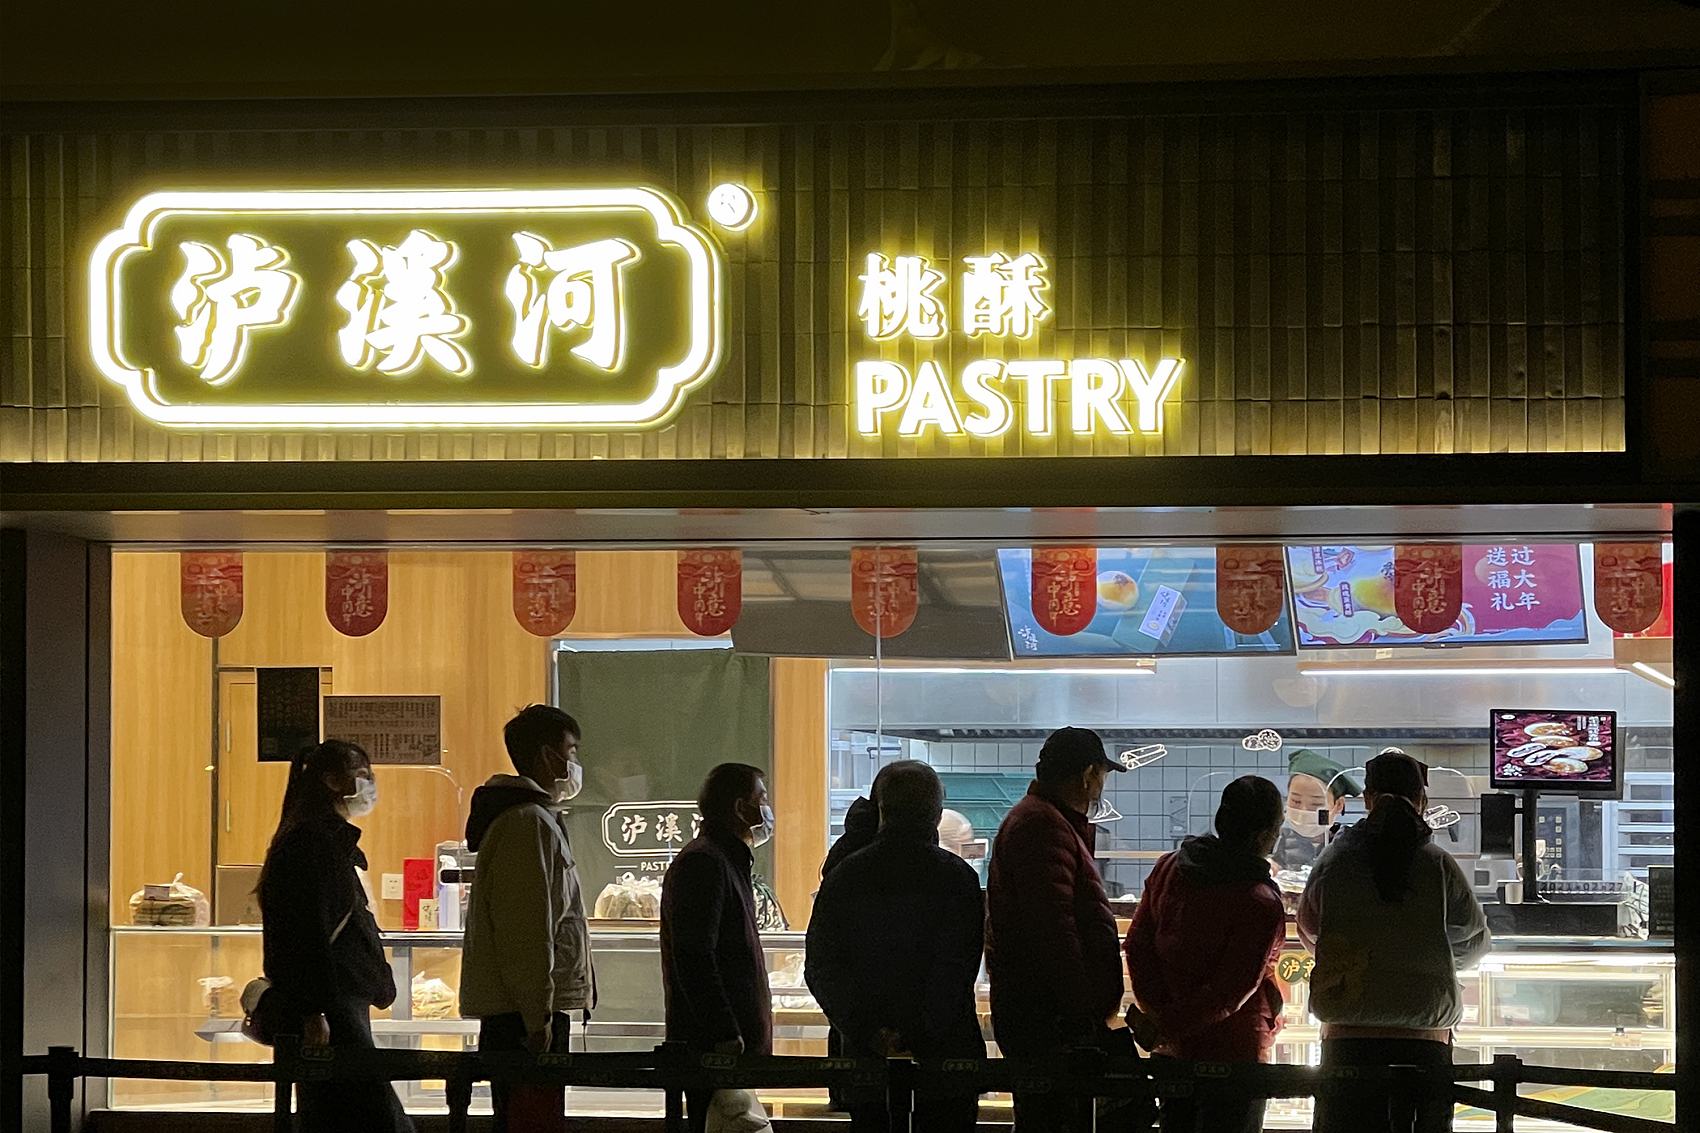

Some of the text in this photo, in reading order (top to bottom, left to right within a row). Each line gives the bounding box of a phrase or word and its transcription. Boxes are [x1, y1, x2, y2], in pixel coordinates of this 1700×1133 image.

[172, 229, 640, 385] 泸溪河
[857, 252, 1053, 341] 桃酥
[856, 358, 1187, 438] PASTRY
[1485, 546, 1515, 612] 送福礼
[1510, 545, 1541, 612] 过大年
